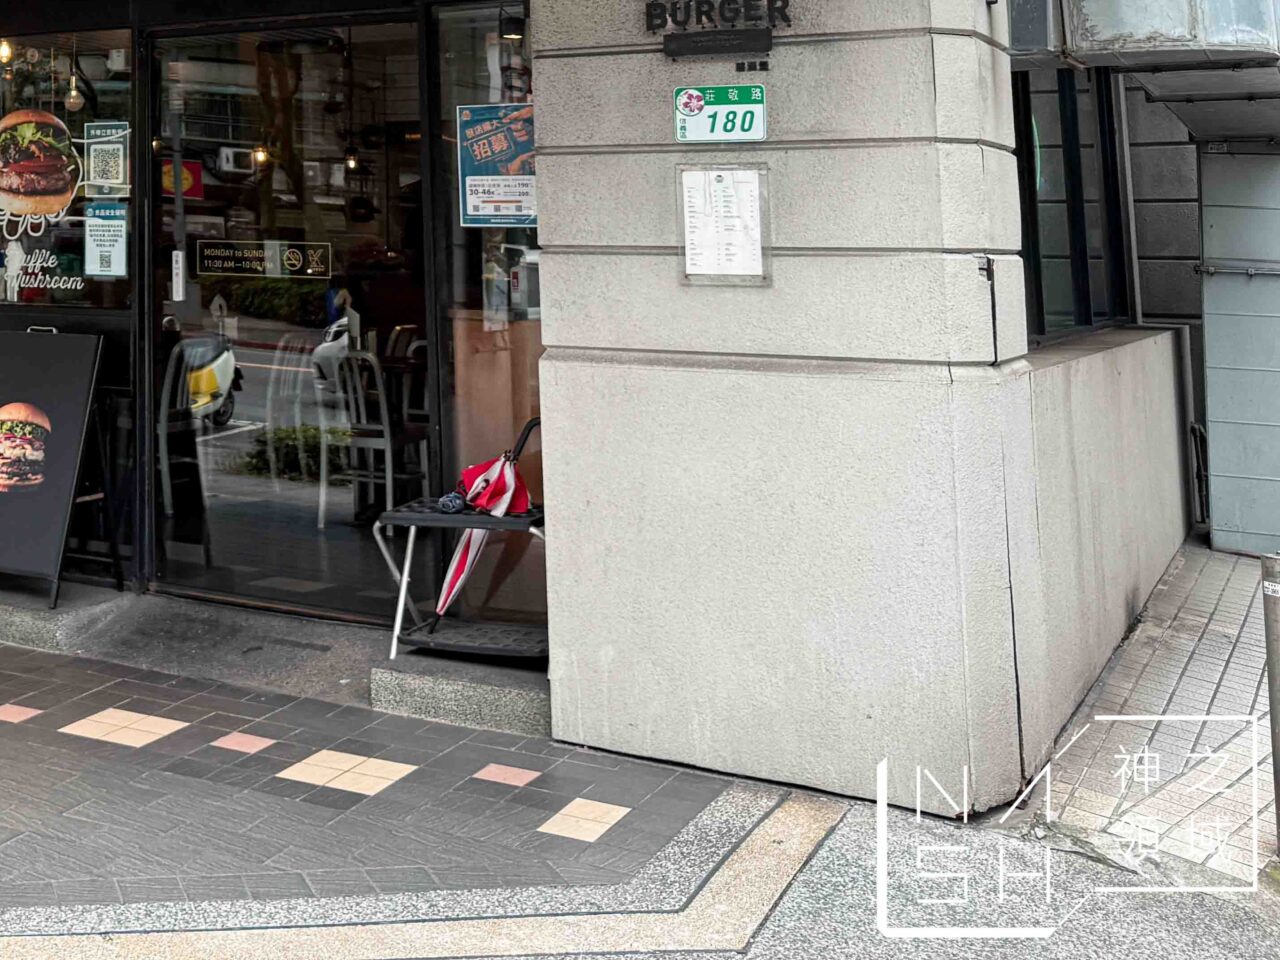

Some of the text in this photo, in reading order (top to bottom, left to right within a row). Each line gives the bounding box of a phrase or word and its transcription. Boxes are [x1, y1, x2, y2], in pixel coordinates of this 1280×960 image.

[705, 88, 762, 102] 莊敬路
[679, 117, 688, 139] 信義區
[707, 110, 756, 134] 180
[472, 132, 509, 160] 招募
[204, 248, 234, 257] MONDAY
[243, 249, 274, 258] SUNDAY
[204, 259, 222, 268] 11:30
